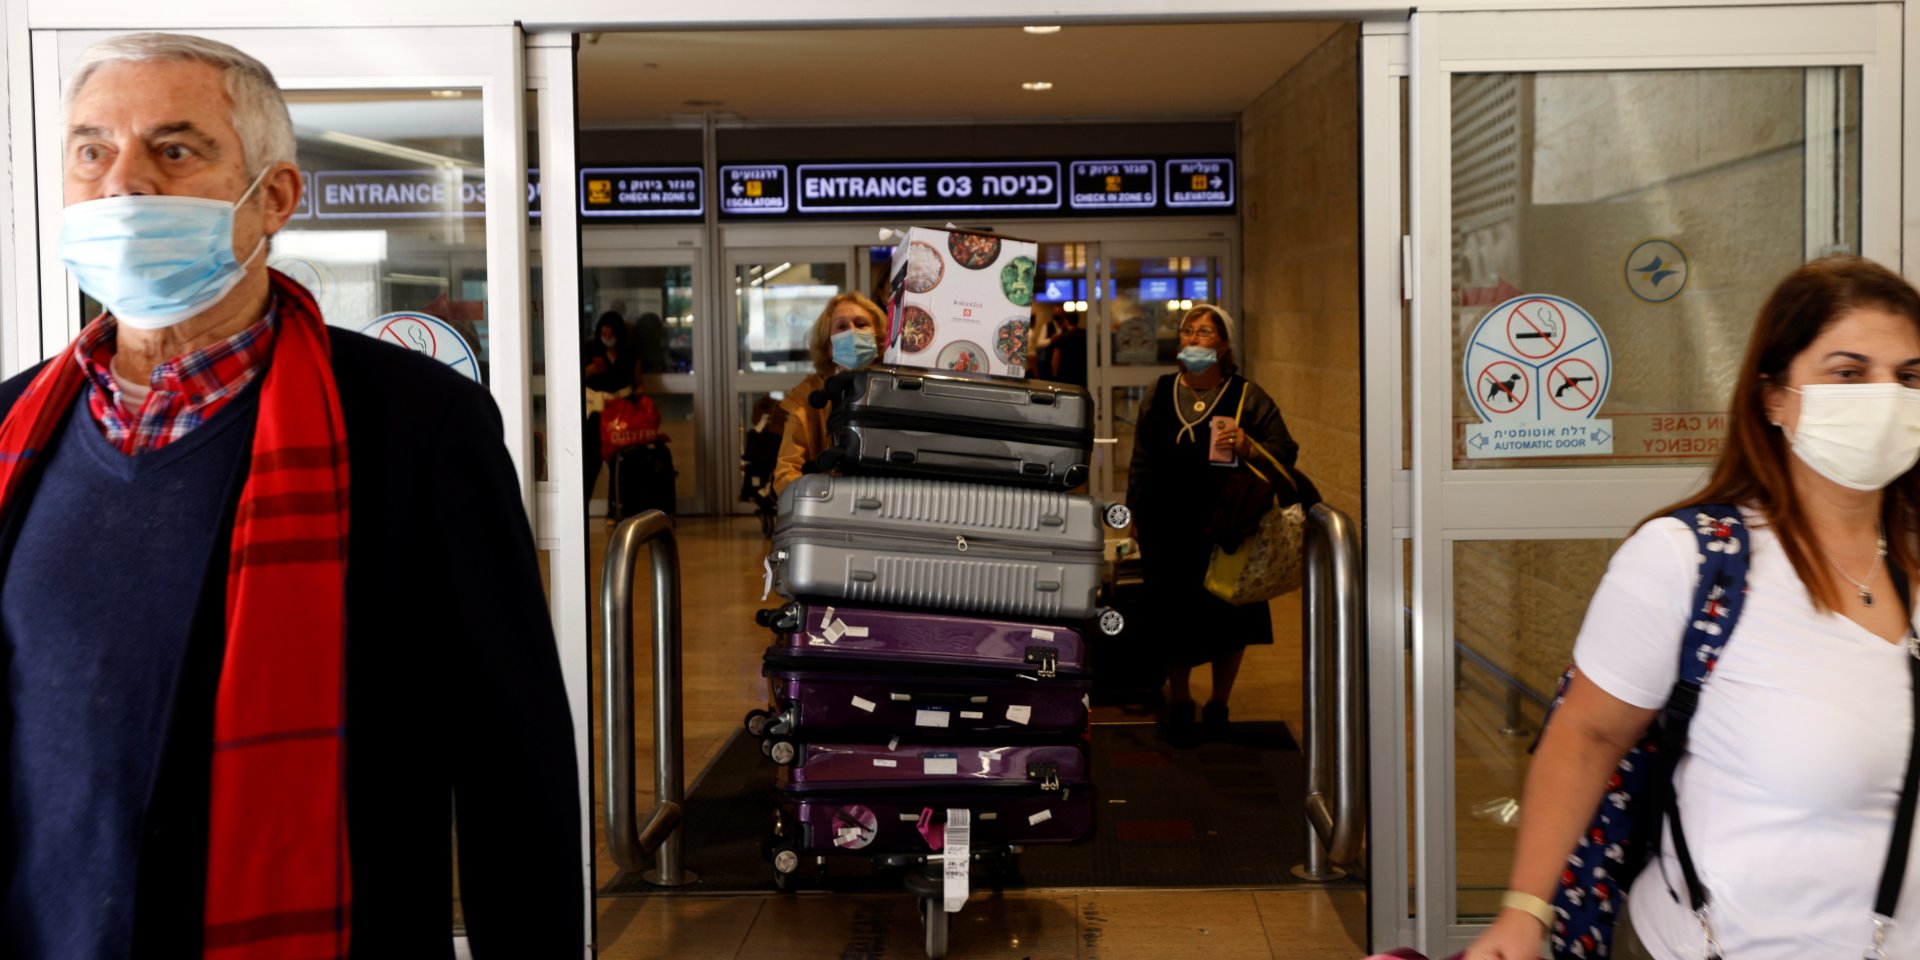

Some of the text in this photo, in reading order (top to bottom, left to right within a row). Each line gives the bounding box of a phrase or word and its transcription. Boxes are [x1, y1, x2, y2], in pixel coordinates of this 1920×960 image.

[1089, 165, 1120, 177] בידוק
[630, 179, 663, 192] בידוק
[805, 174, 1053, 198] ENTRANCE 03 כניסה
[324, 183, 446, 205] ENTRANCE
[618, 191, 696, 203] CHECK IN ZONE G
[1075, 193, 1106, 202] CHECK
[1107, 193, 1118, 202] IN
[1118, 192, 1143, 202] ZONE
[1173, 191, 1226, 201] ELEVATORS
[726, 197, 783, 208] ESCALATORS
[1494, 425, 1586, 439] דלת אוטומטית
[1494, 439, 1586, 451] AUTOMATIC DOOR
